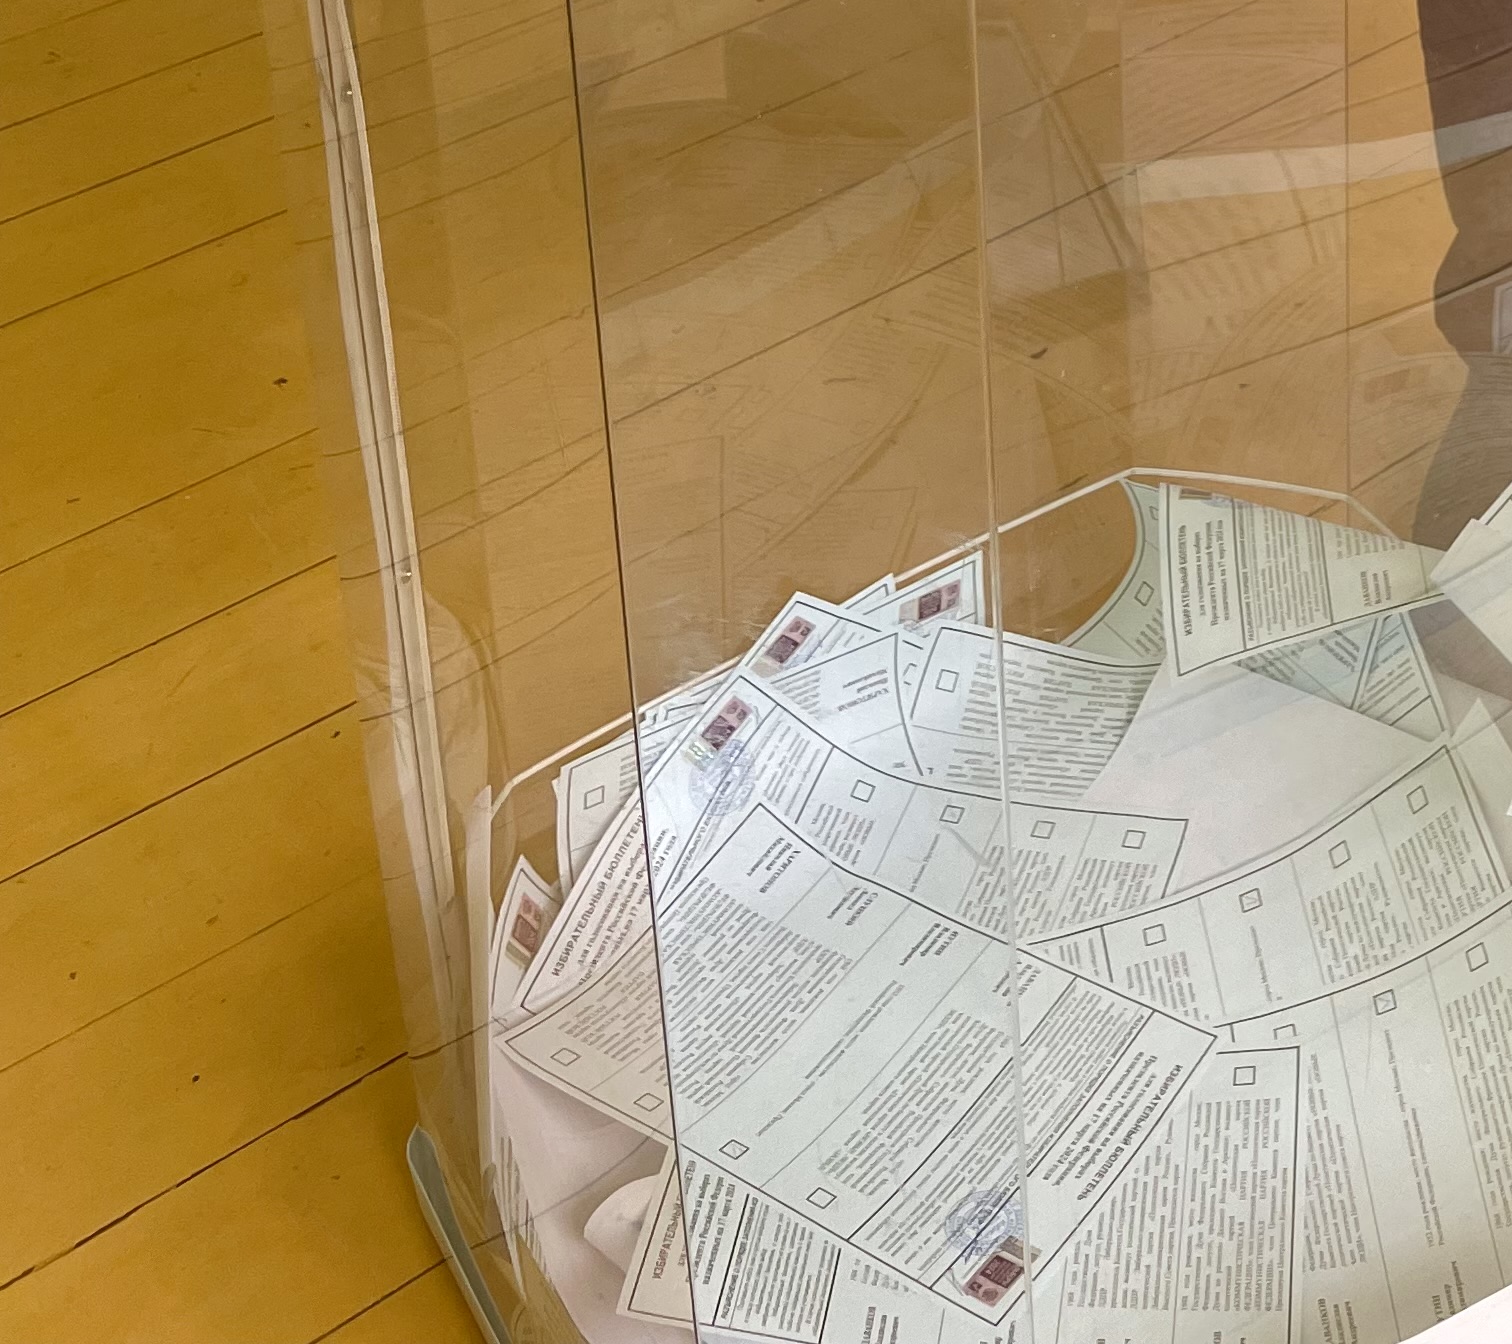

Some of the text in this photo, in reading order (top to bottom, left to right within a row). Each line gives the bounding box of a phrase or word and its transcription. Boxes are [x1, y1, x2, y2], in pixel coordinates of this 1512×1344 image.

[548, 879, 610, 977] ИЗБИРАТЕЛЬНЫЙ
[1088, 1111, 1100, 1124] 17
[1118, 1062, 1186, 1148] ИЗБИРАТЕЛЬНЫЙ
[1075, 1143, 1125, 1204] БЮЛЛЕТЕНЬ
